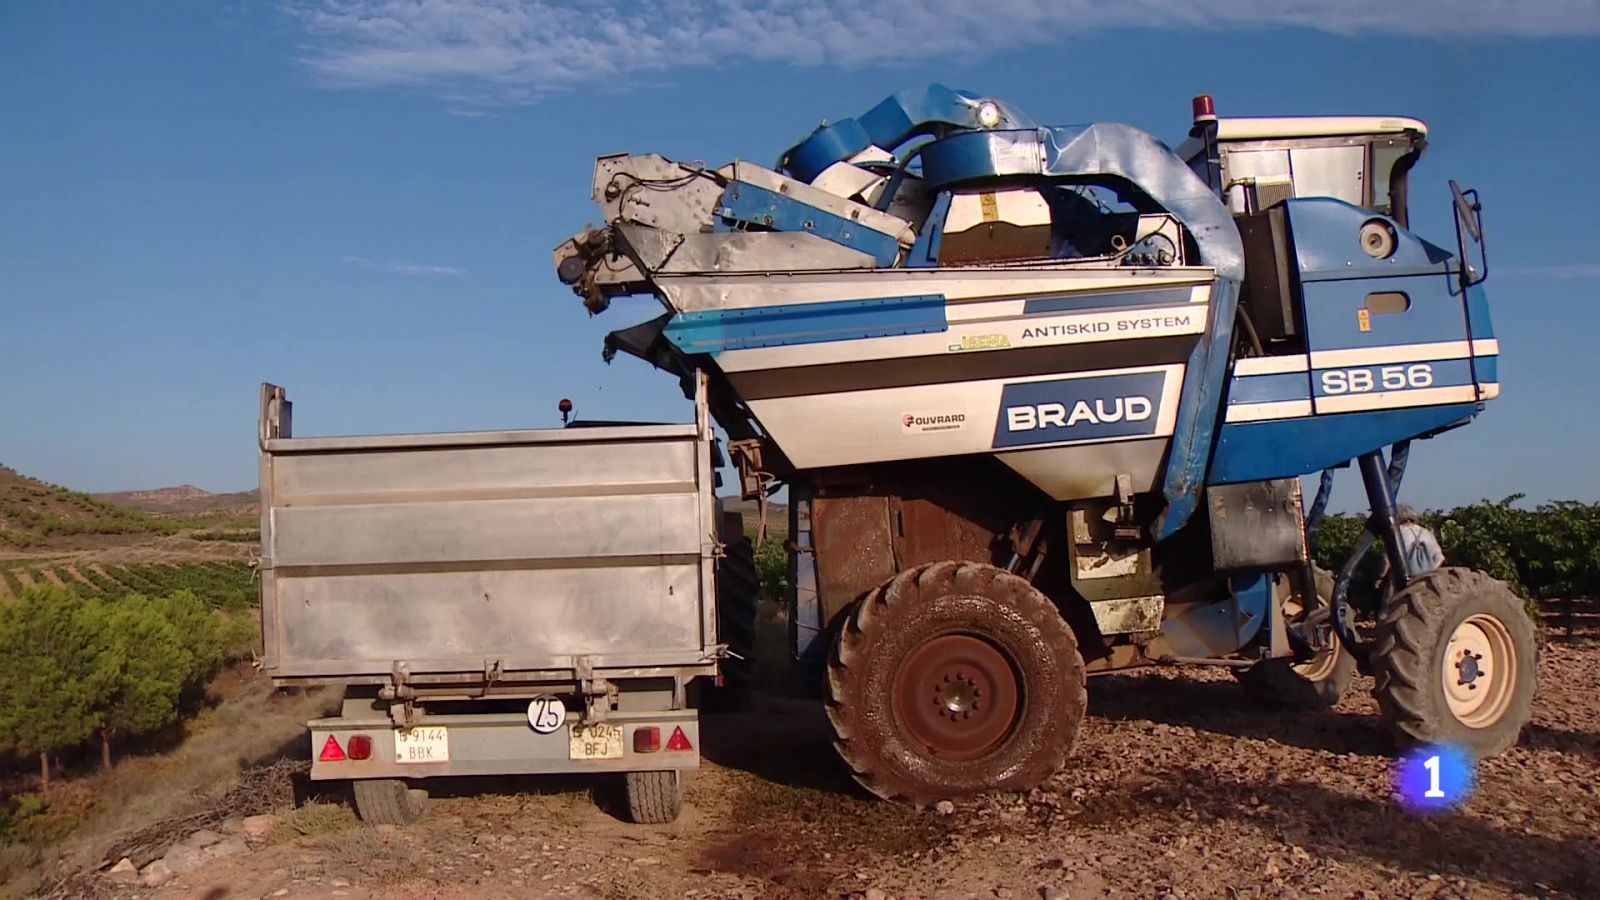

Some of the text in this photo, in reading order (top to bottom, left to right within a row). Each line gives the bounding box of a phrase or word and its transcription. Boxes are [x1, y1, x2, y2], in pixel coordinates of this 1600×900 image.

[1022, 315, 1191, 340] ANTISKID SYSTEM
[1321, 364, 1433, 395] SB 56
[1007, 396, 1152, 432] BRAUD
[535, 697, 559, 728] 25
[409, 746, 433, 760] BBK
[585, 742, 608, 756] BFJ
